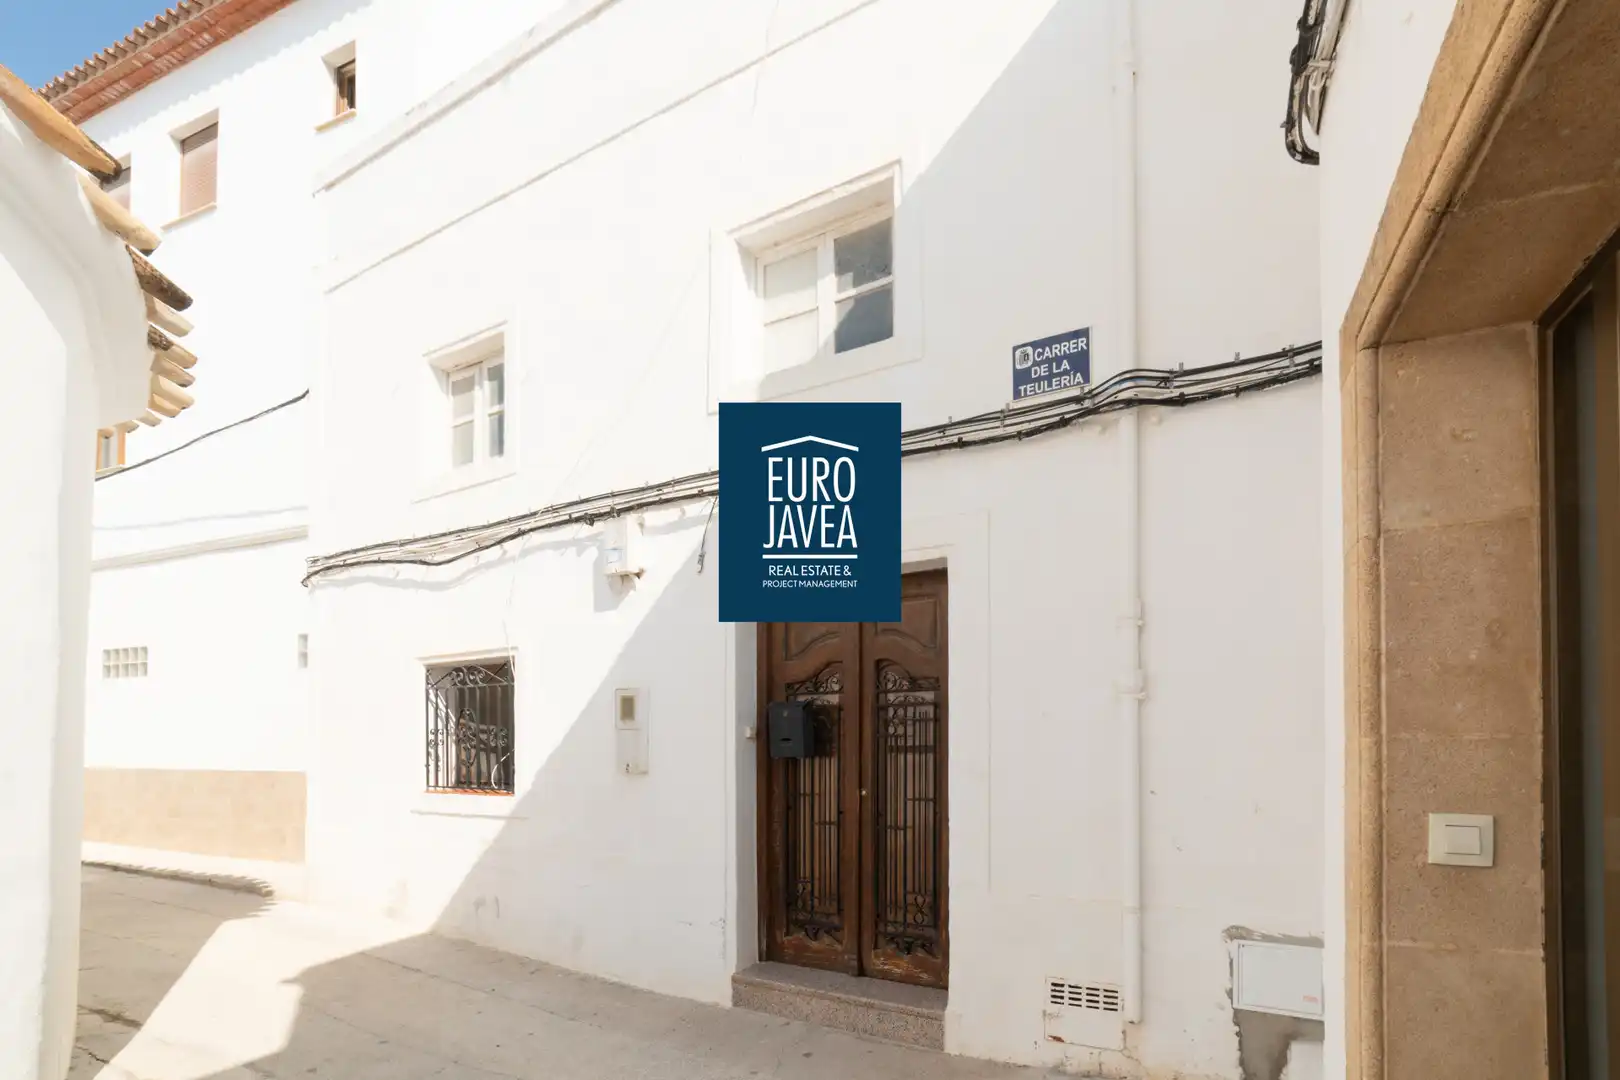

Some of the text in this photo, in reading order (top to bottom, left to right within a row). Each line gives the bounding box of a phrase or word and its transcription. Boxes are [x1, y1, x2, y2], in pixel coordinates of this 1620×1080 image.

[1034, 337, 1088, 361] CARRER
[1031, 359, 1070, 378] DE LA
[1018, 370, 1084, 397] TEULERÍA
